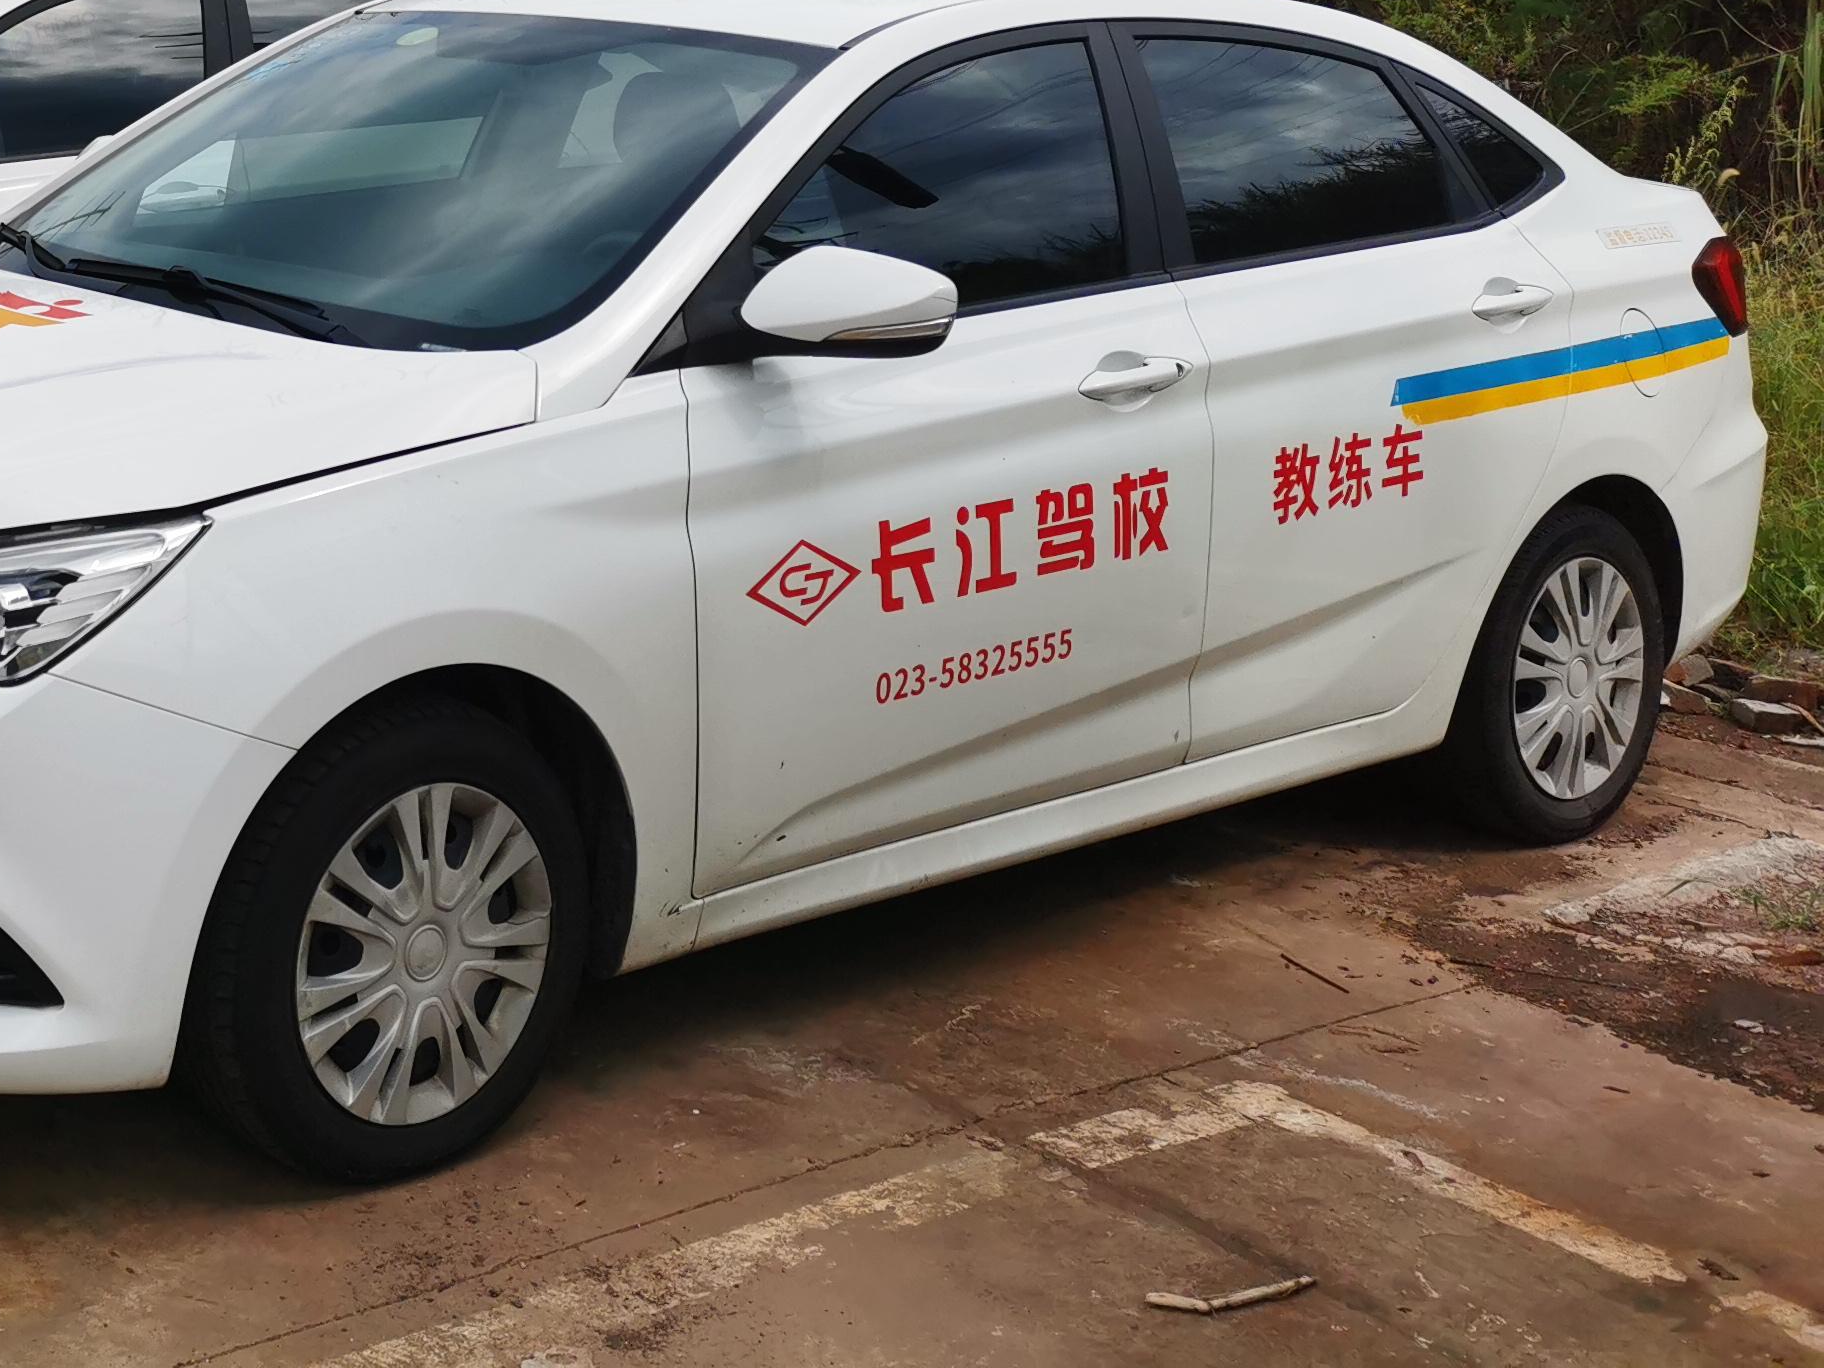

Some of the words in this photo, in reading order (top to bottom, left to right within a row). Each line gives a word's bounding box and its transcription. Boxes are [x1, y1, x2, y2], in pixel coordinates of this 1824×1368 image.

[1272, 424, 1425, 526] 教练车
[871, 467, 1170, 613] 长江驾校
[875, 628, 1074, 705] 023-58325555
